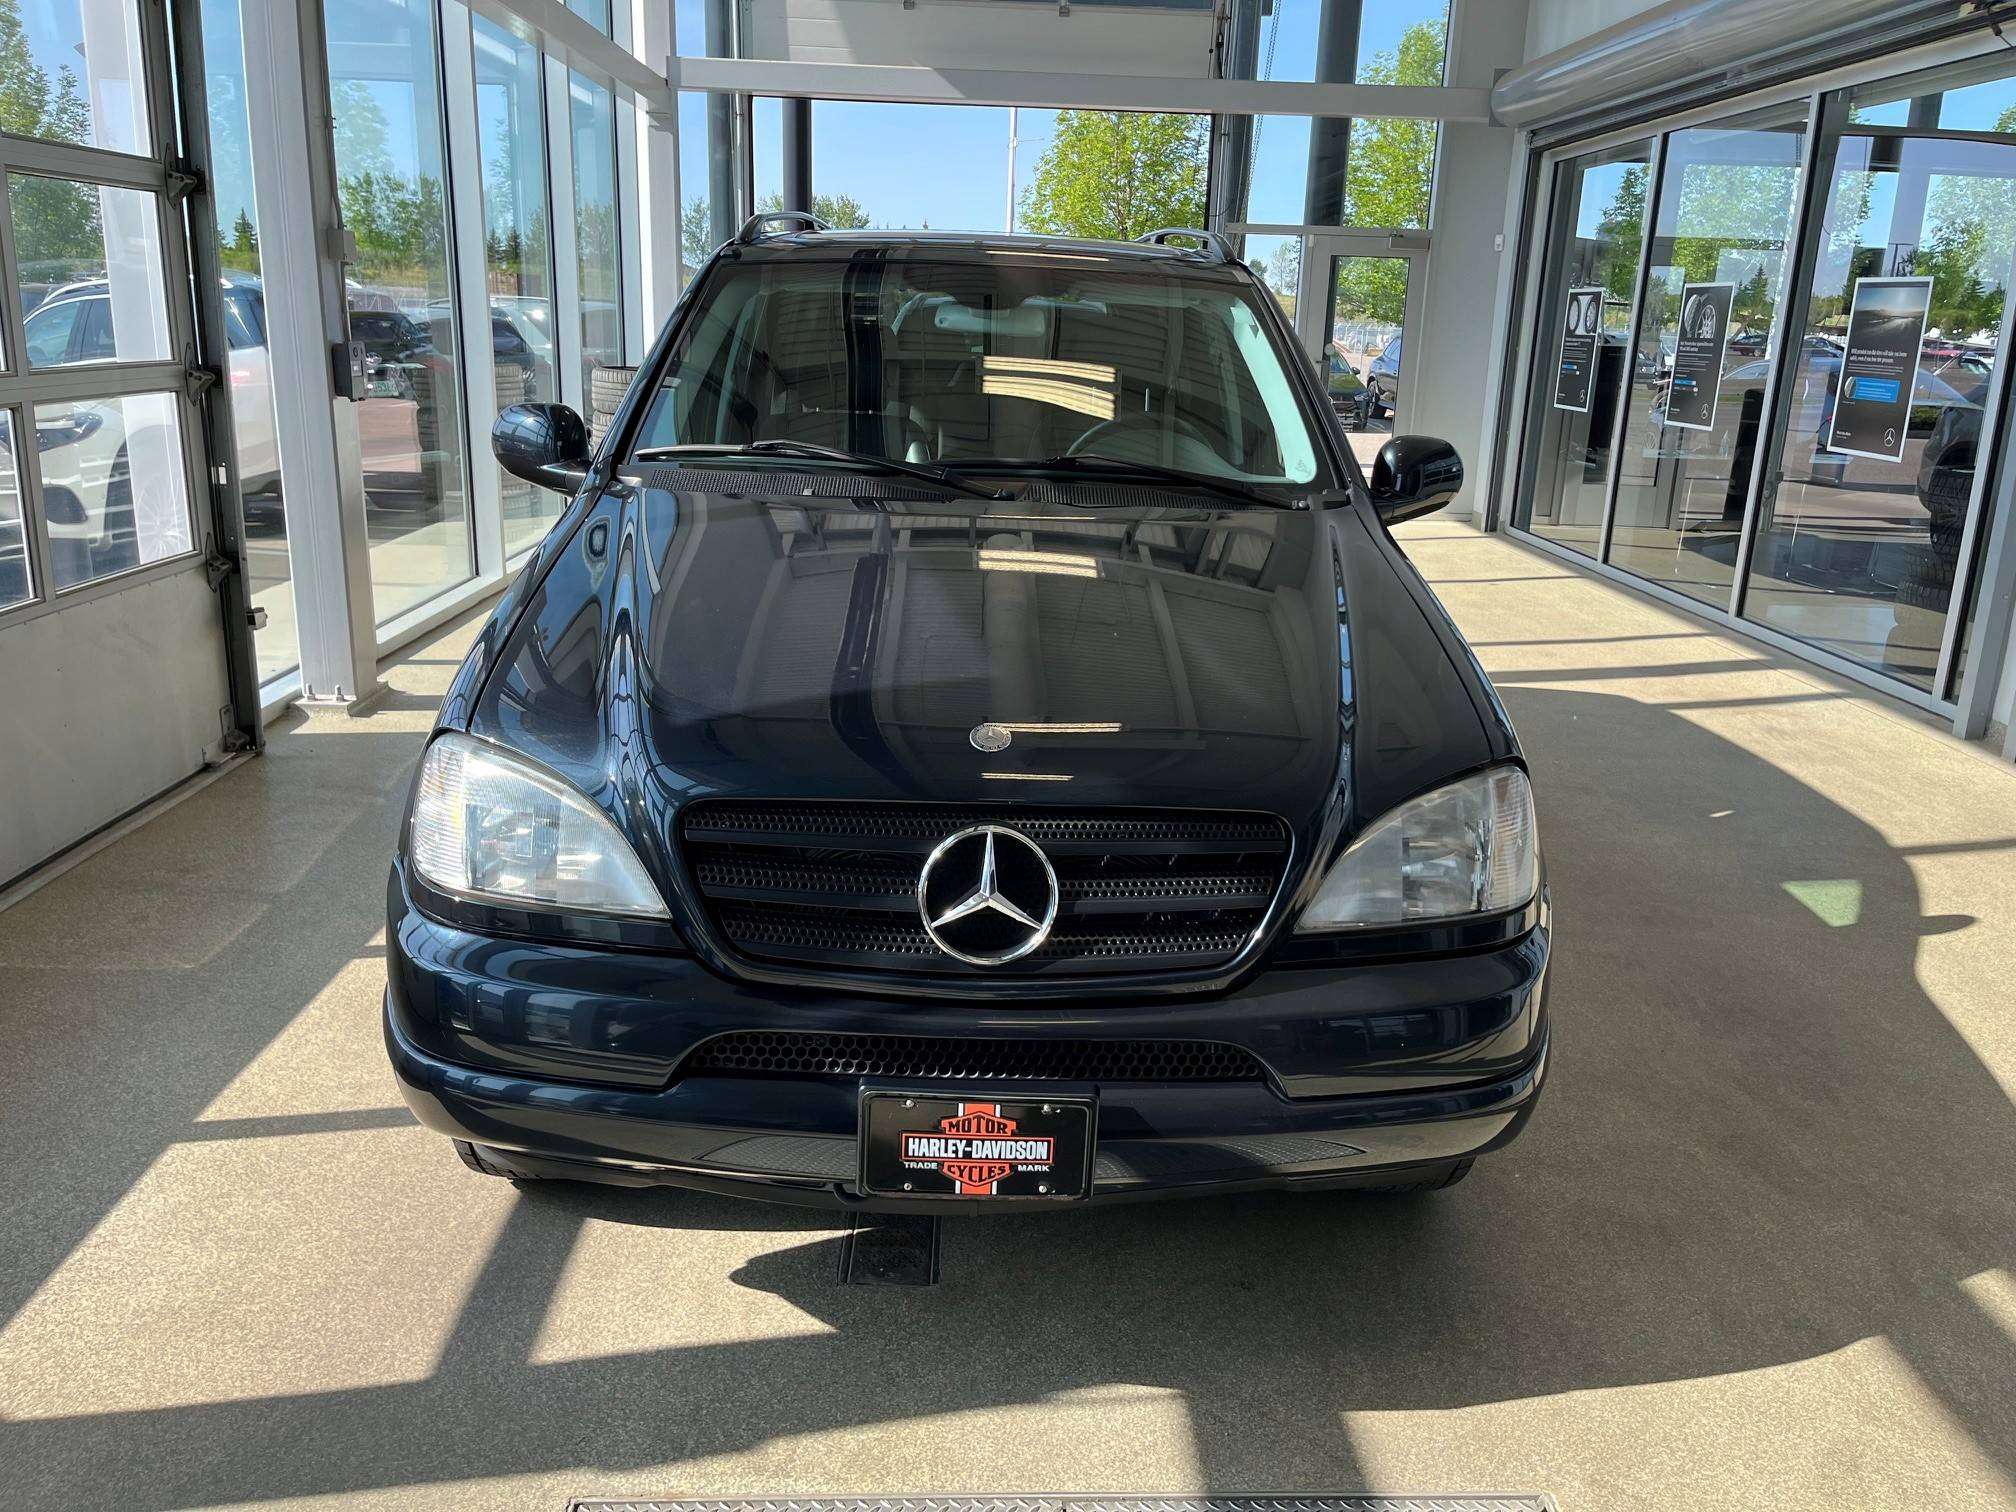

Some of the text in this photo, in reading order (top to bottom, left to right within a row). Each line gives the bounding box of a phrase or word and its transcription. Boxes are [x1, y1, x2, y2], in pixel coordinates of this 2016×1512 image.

[948, 1115, 1008, 1134] MOTOR
[908, 1137, 1048, 1160] HARLEY-DAVIDSON
[904, 1161, 1050, 1172] TRADE MARK
[947, 1165, 1006, 1184] CYCLES
